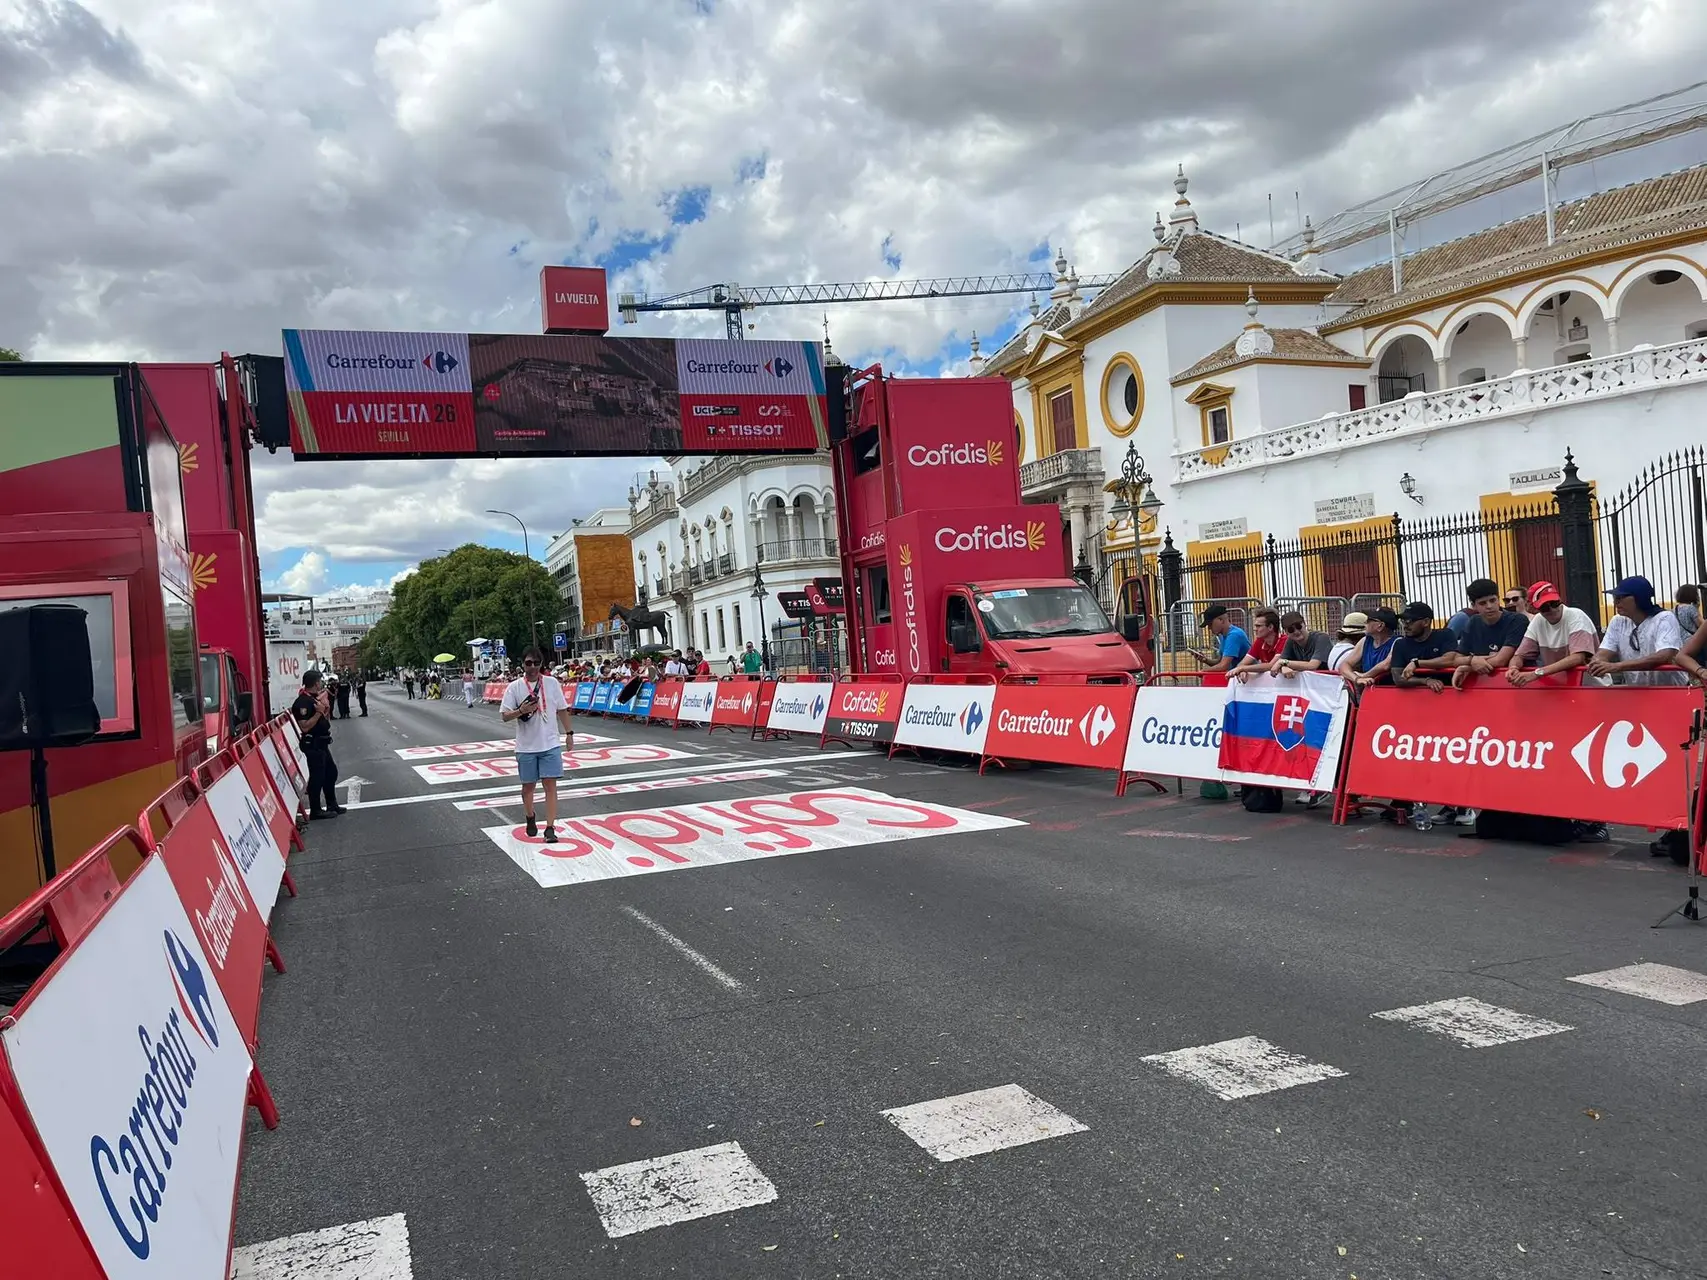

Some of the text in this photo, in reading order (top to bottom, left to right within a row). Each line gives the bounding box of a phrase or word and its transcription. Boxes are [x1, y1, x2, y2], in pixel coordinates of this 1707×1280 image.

[555, 292, 599, 304] LA VUELTA
[327, 353, 416, 370] Carrefour
[686, 360, 760, 374] Carrefour
[335, 404, 456, 423] LA VUELTA 26
[377, 431, 410, 442] SEVILLA
[729, 424, 784, 436] TISSOT
[908, 443, 988, 467] Cofidis
[1510, 471, 1561, 485] TAQUILLAS
[1330, 496, 1357, 505] SOMBRA
[1211, 520, 1233, 528] SOMBRA
[861, 531, 885, 550] Cofidis
[934, 524, 1028, 552] Cofidis
[903, 566, 921, 673] Cofidis
[278, 653, 300, 680] rtve
[682, 694, 703, 708] Carrefour
[716, 695, 741, 710] Carrefour
[775, 698, 808, 714] Carrefour
[842, 691, 879, 714] Cofidis
[905, 704, 956, 728] Carrefour
[997, 708, 1074, 737] Carrefour
[850, 722, 879, 737] TISSOT
[1370, 724, 1554, 770] Carrefour
[511, 791, 960, 869] Cofidis
[228, 818, 262, 875] Carrefour
[195, 876, 238, 970] Carrefour
[90, 1006, 197, 1261] Carrefour
